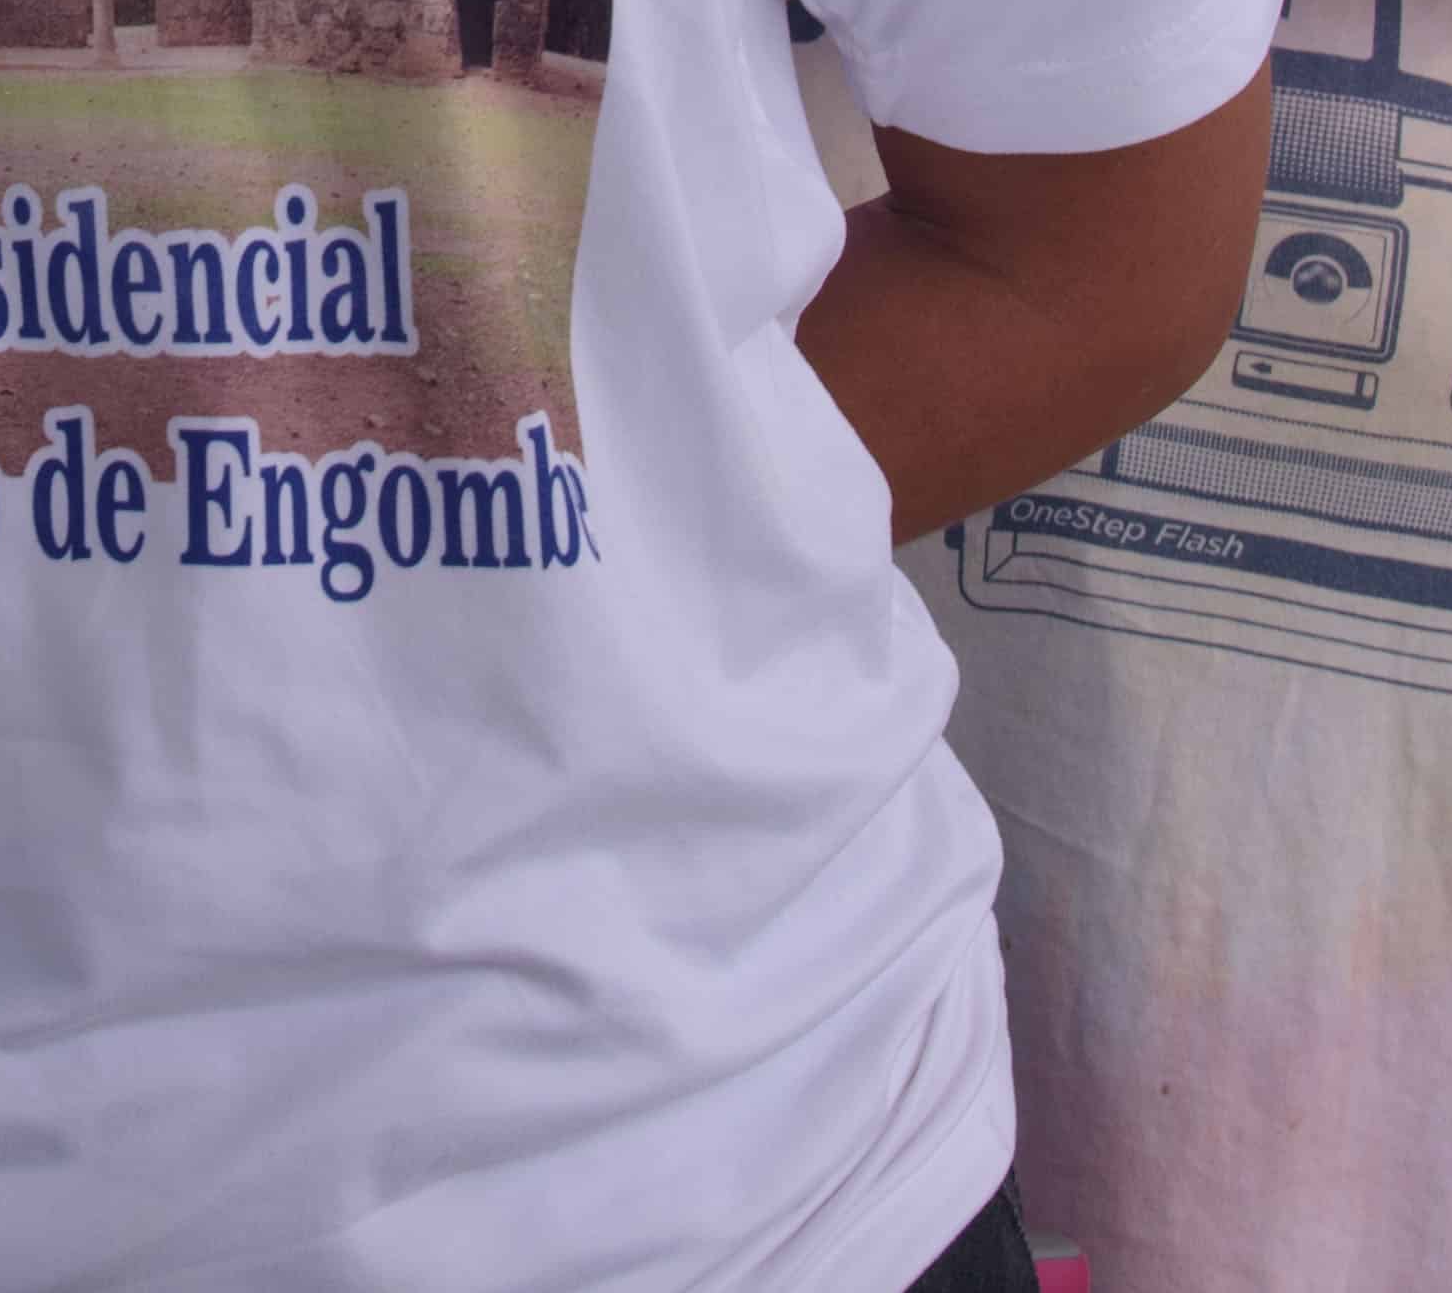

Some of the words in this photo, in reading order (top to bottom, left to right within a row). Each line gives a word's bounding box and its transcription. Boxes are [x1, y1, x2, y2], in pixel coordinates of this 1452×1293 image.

[31, 415, 148, 565] de
[1009, 496, 1146, 545] OneStep
[1154, 520, 1244, 559] Flash
